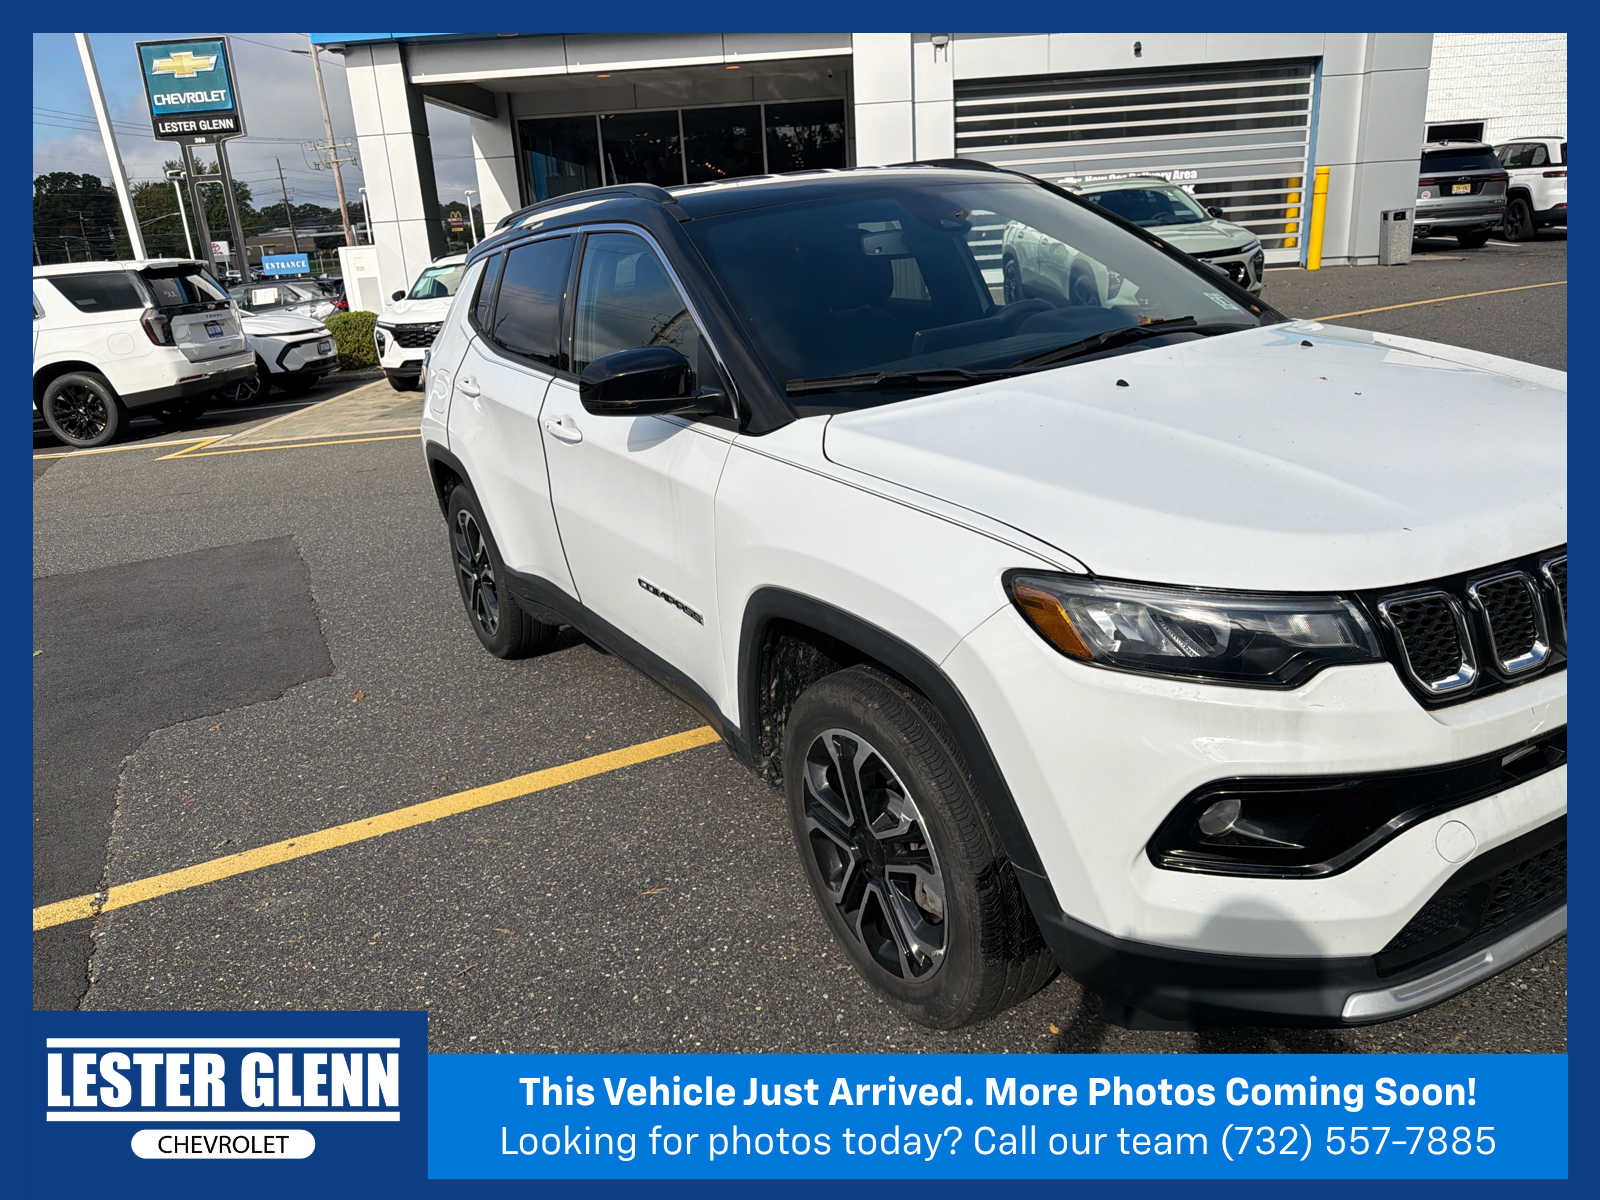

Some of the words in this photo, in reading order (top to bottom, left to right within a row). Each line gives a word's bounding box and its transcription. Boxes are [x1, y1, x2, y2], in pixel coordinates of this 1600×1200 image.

[153, 89, 227, 106] CHEVROLET
[158, 122, 197, 133] LESTER
[199, 118, 234, 131] GLENN
[1172, 169, 1198, 180] Area
[265, 260, 307, 270] ENTRANCE
[637, 578, 704, 626] COMPASS
